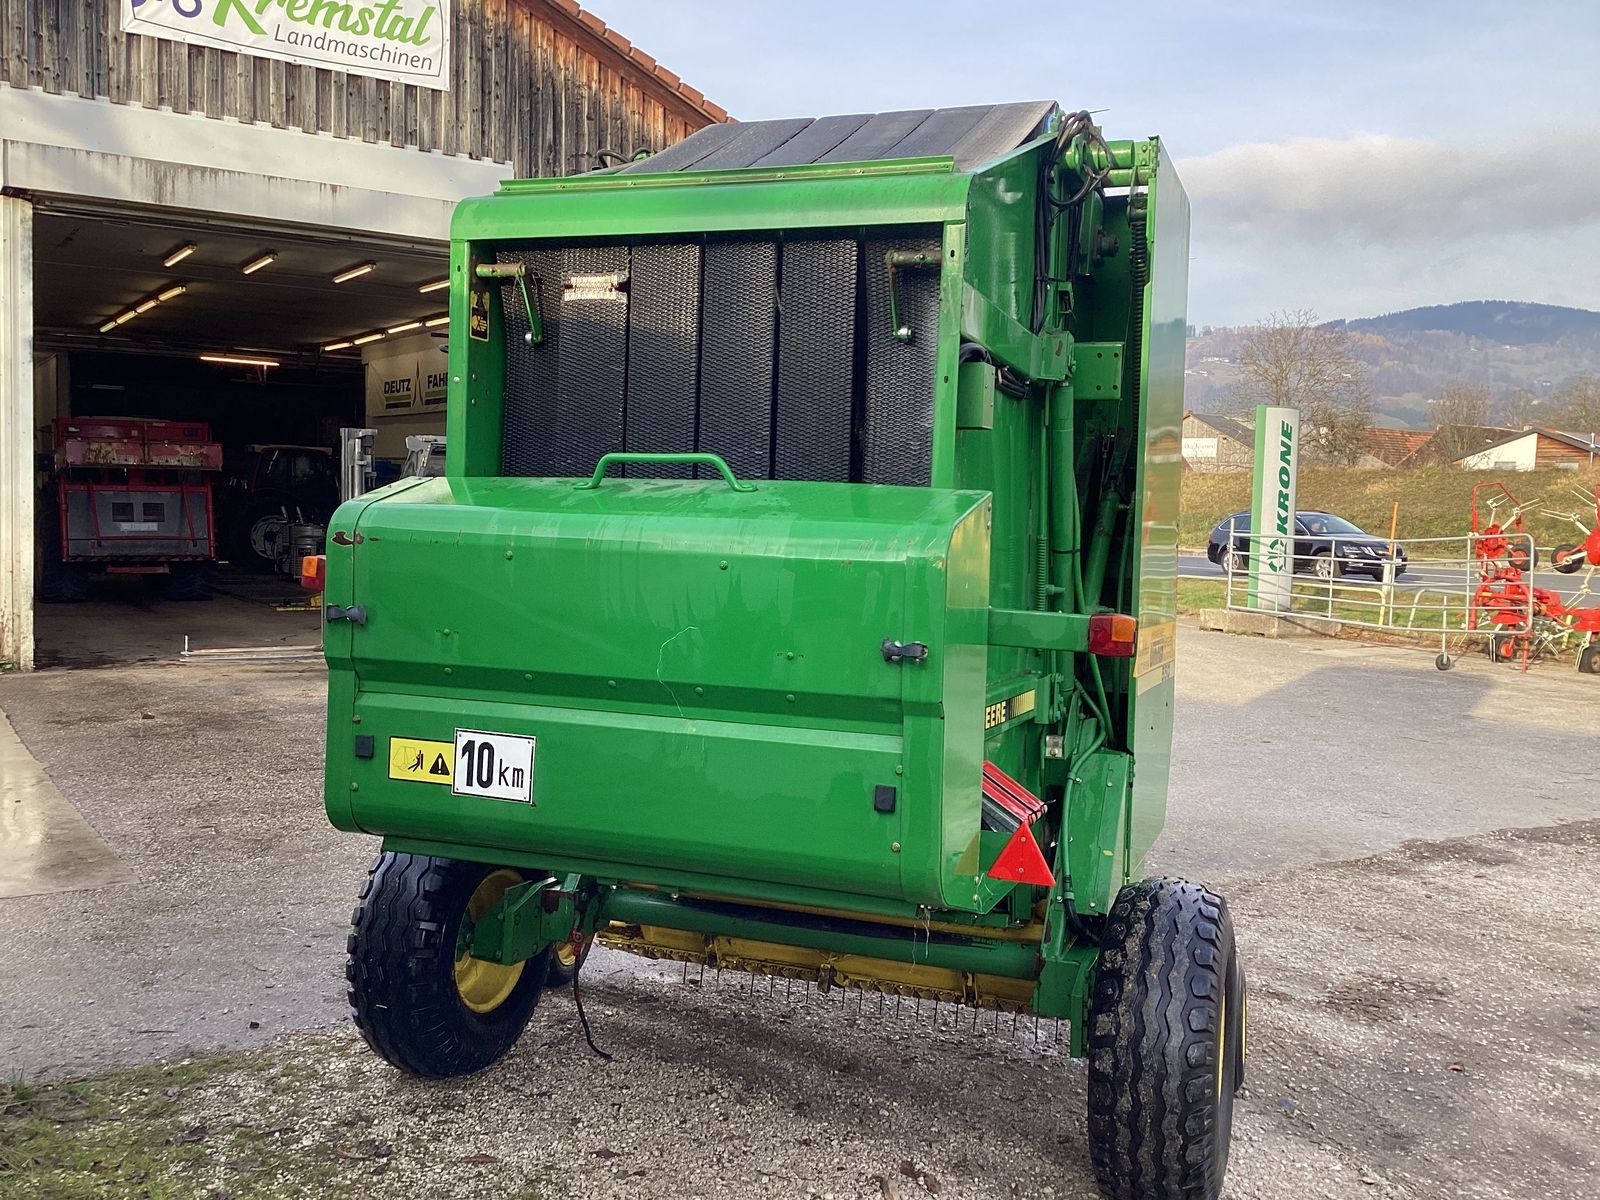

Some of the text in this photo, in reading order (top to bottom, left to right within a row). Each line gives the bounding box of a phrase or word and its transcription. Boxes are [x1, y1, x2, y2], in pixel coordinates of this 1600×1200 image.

[212, 0, 436, 46] Kremstal
[274, 24, 432, 71] Landmaschinen
[384, 378, 411, 393] DEUTZ
[1276, 419, 1293, 535] KRONE
[985, 701, 1006, 730] EERE
[461, 740, 525, 789] 10 km
